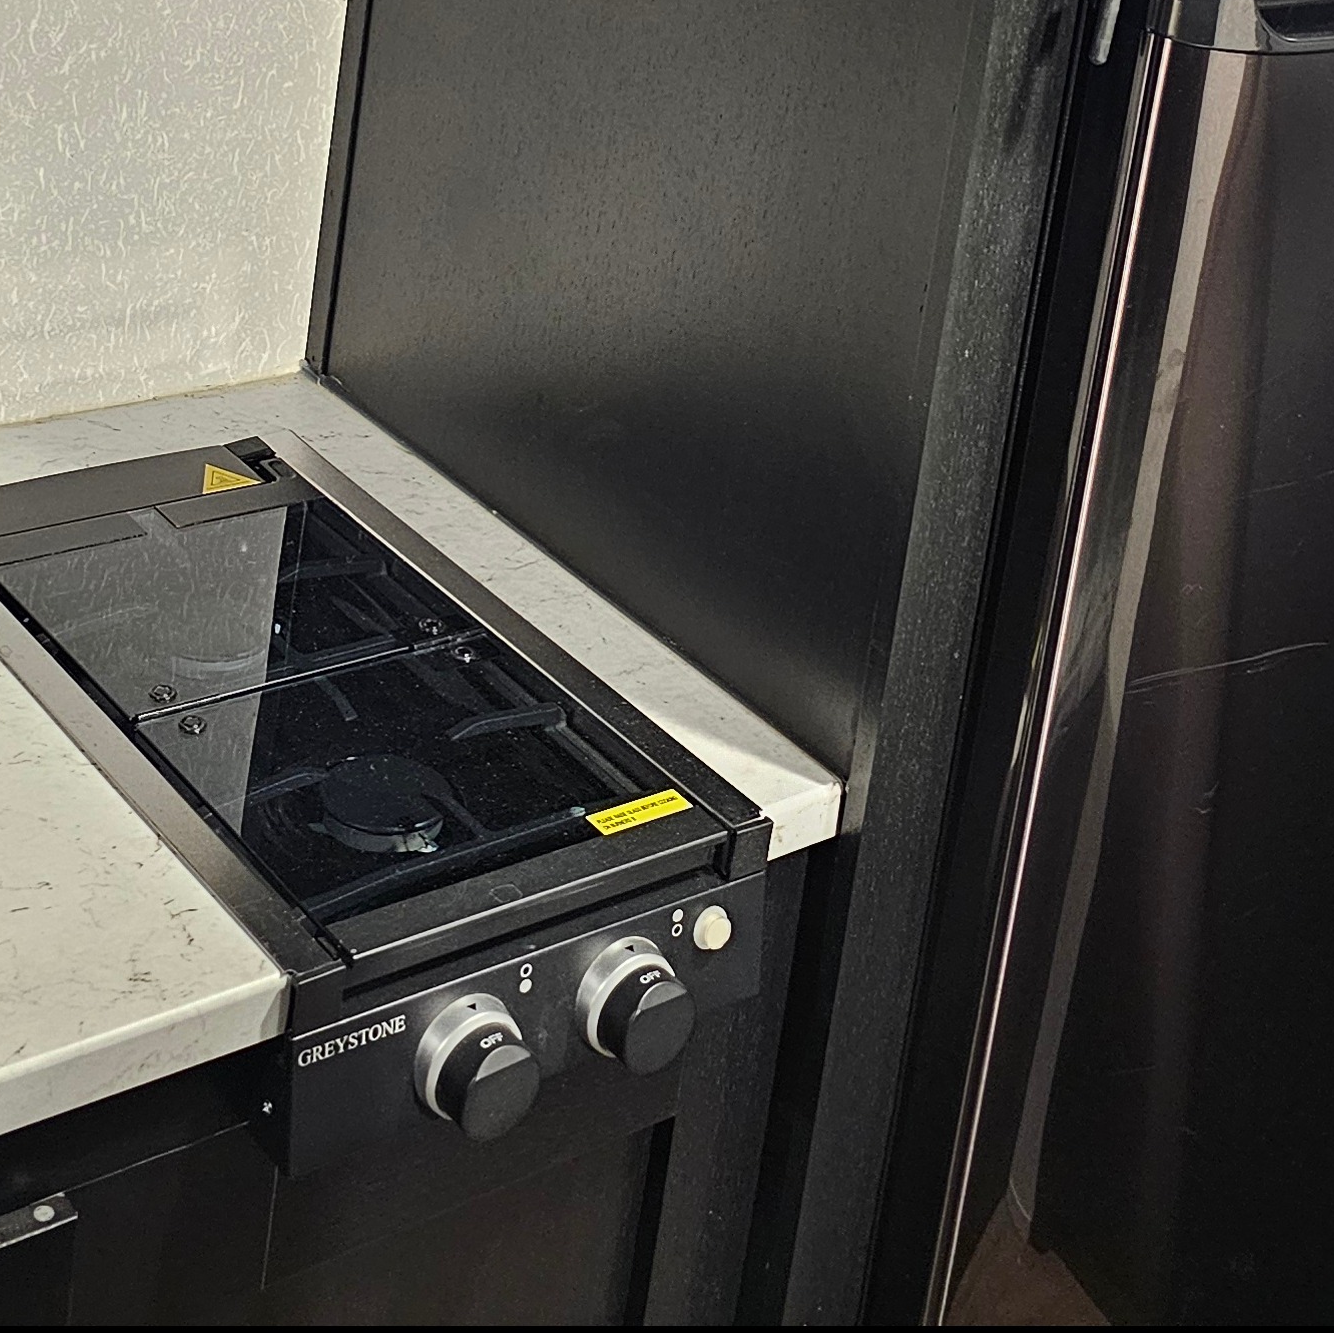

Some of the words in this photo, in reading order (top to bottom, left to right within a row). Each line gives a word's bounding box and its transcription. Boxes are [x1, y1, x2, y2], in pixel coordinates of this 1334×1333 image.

[640, 970, 661, 984] OFF
[297, 1014, 406, 1067] GREYSTONE
[479, 1032, 504, 1049] OFF
